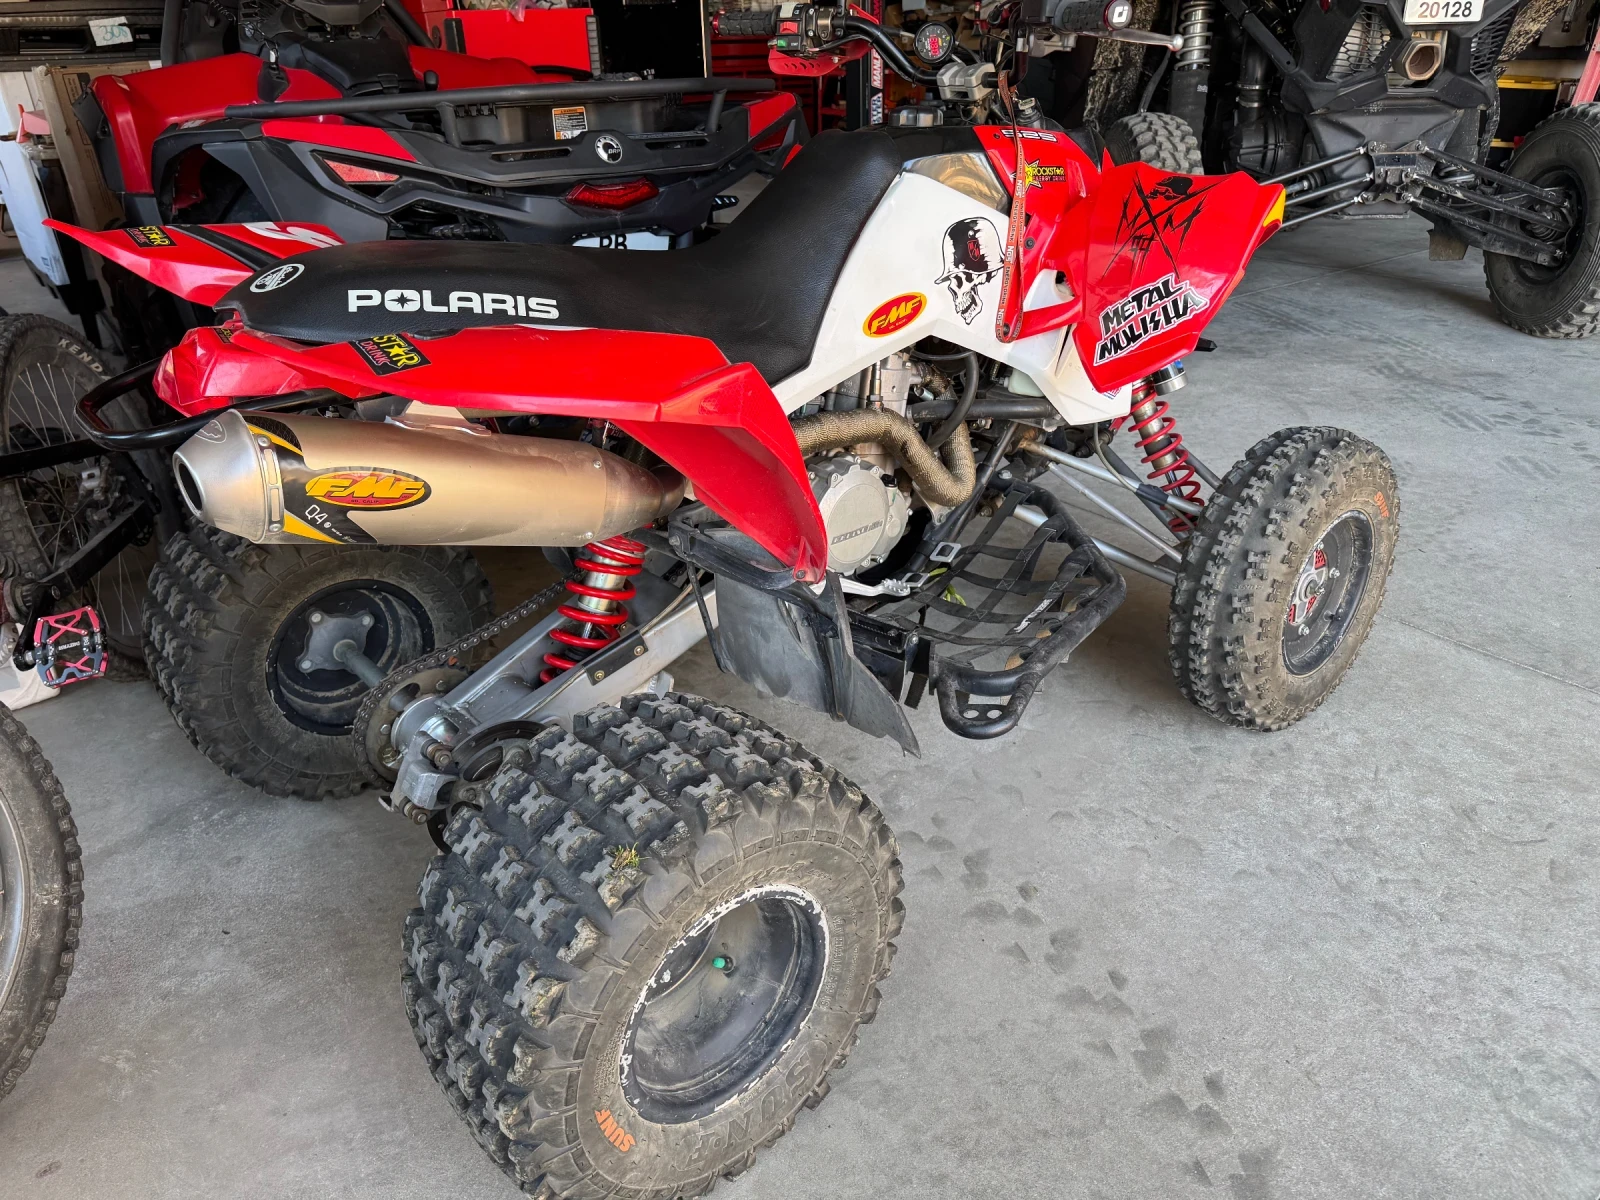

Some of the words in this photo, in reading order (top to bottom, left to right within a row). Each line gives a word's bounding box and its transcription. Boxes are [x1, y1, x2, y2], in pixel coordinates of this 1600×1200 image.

[1418, 1, 1472, 18] 20128
[1032, 166, 1064, 176] ROCKSTAR
[1005, 246, 1015, 264] NOS
[348, 290, 560, 320] POLARIS
[870, 296, 921, 334] FMF
[1101, 278, 1184, 335] METAL
[1099, 292, 1207, 361] MULISHA
[361, 340, 390, 365] DRINK
[306, 476, 424, 499] FMF
[305, 504, 328, 525] Q4
[594, 1108, 636, 1152] SUNF
